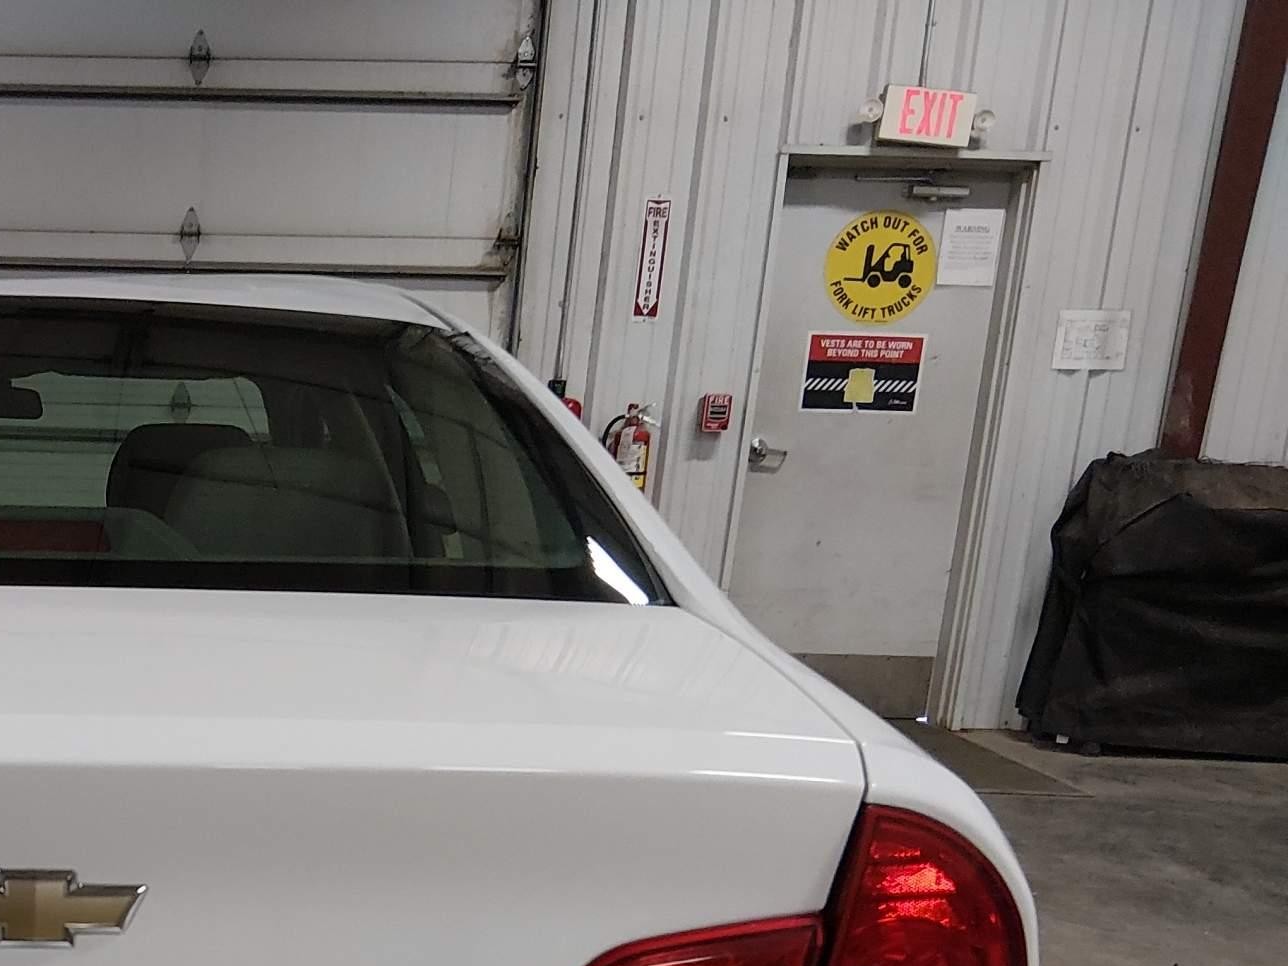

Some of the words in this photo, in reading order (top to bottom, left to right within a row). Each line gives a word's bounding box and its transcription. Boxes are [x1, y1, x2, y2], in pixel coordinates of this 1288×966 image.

[899, 89, 964, 138] EXIT
[647, 206, 668, 218] FIRE
[835, 216, 878, 252] WATCH
[883, 215, 910, 233] OUT
[907, 228, 929, 255] FOR
[642, 220, 660, 310] EXTINGUISHER
[830, 280, 853, 310] FORK
[851, 303, 876, 319] LIFT
[880, 284, 922, 319] TRUCKS
[820, 339, 846, 348] VESTS
[846, 340, 862, 348] ARE
[863, 340, 874, 348] TO
[876, 340, 886, 349] BE
[888, 341, 913, 350] WORN
[826, 348, 859, 357] BEYOND
[861, 349, 879, 358] THIS
[879, 349, 904, 359] POINT
[709, 395, 730, 405] FIRE
